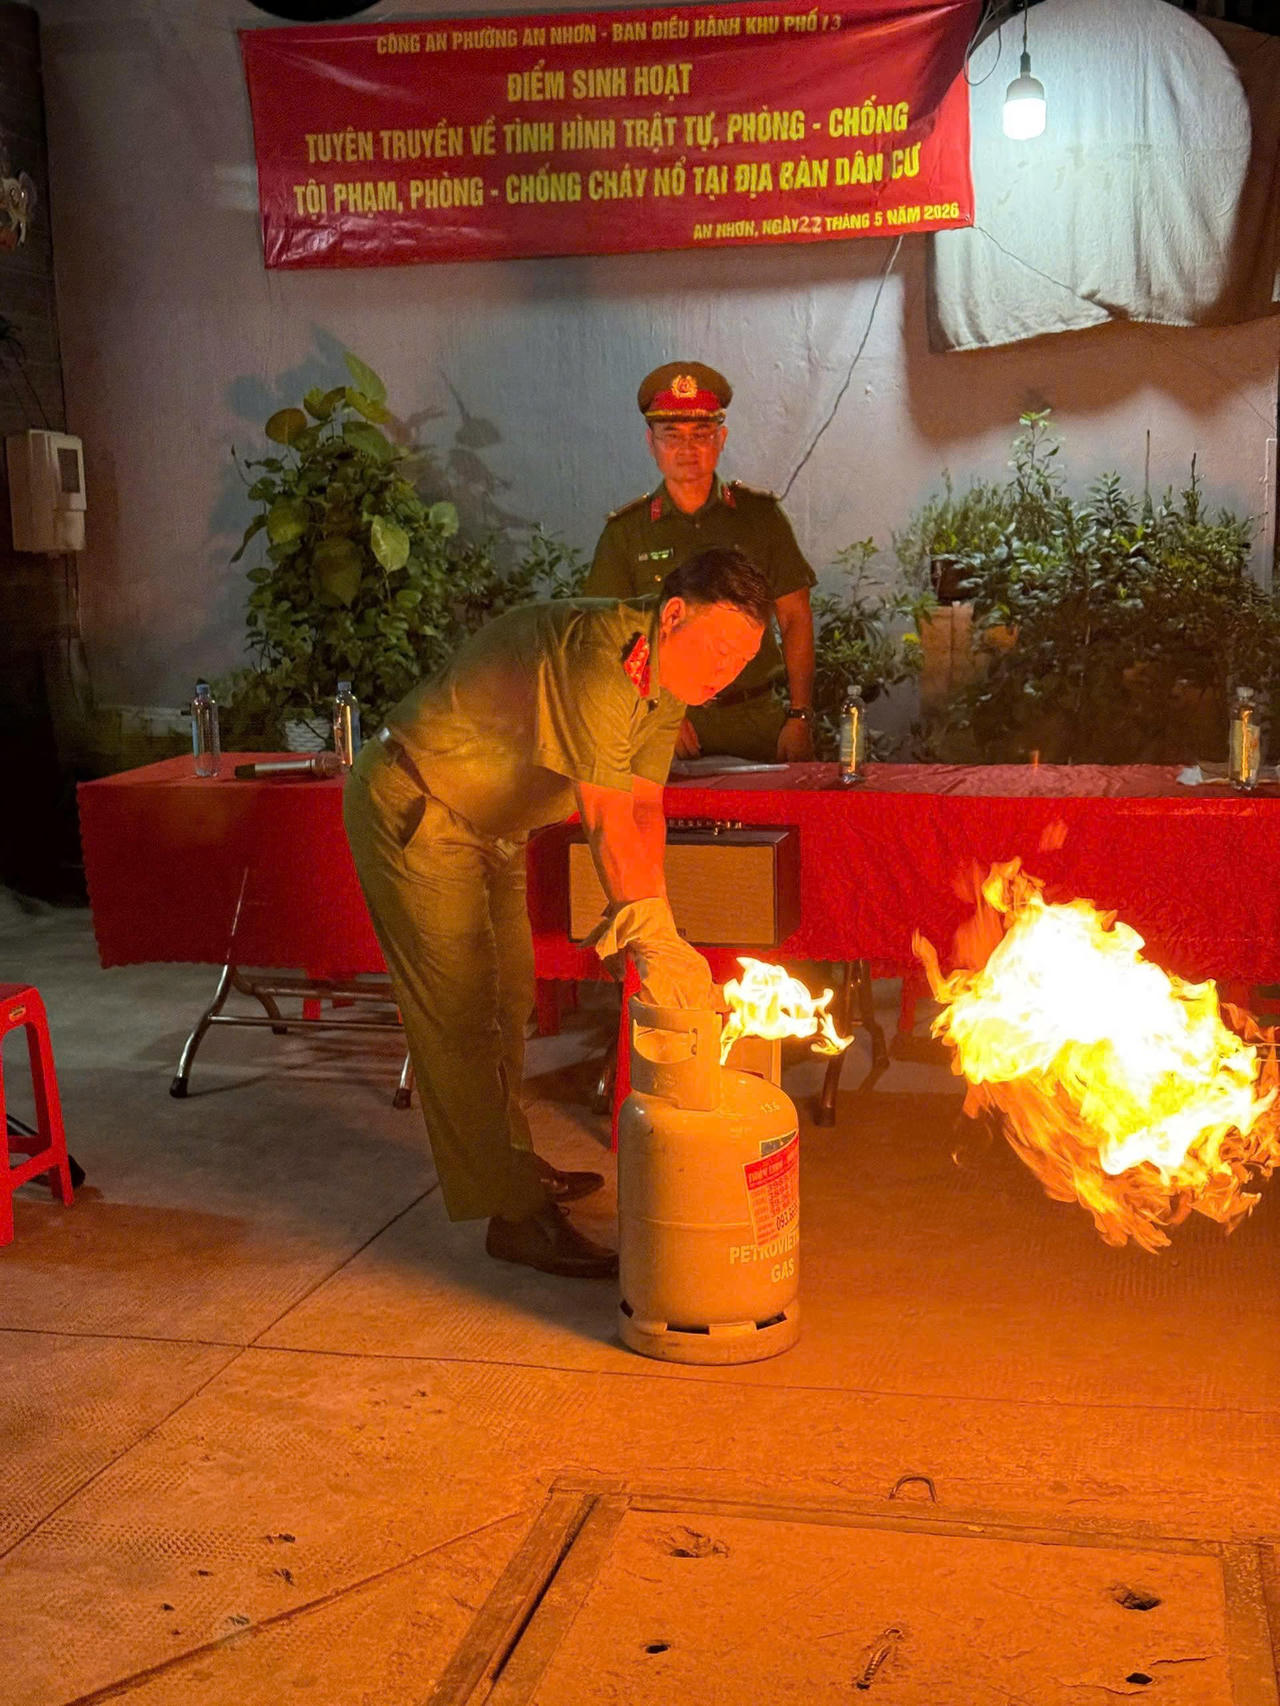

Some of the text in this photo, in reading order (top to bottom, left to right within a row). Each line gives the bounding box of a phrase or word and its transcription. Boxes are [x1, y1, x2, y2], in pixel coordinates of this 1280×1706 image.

[376, 32, 420, 54] CÔNG
[425, 33, 448, 52] AN
[452, 25, 518, 50] PHƯỜNG
[522, 27, 546, 46] AN
[550, 23, 597, 44] NHƠN
[612, 22, 648, 42] BAN
[694, 14, 741, 38] HÀNH
[746, 15, 780, 35] KHU
[784, 7, 819, 32] PHỐ
[507, 58, 693, 102] ĐIỂM SINH HOẠT
[305, 125, 374, 163] TUYÊN
[379, 117, 464, 161] TRUYỀN
[470, 114, 497, 156] VỀ
[503, 117, 555, 154] TÌNH
[561, 113, 616, 150] HÌNH
[622, 111, 677, 154] TRẬT
[683, 111, 719, 152] TỰ,
[727, 104, 806, 144] PHÒNG
[828, 94, 909, 138] CHỐNG
[293, 177, 328, 221] TỘI
[333, 180, 404, 219] PHẠM,
[409, 170, 484, 210] PHÒNG
[505, 162, 582, 205] CHỐNG
[588, 162, 648, 200] CHÁY
[653, 155, 687, 198] NỔ
[692, 164, 729, 201] TẠI
[734, 162, 773, 199] ĐỊA
[779, 154, 830, 191] BÀN
[835, 150, 884, 187] DÂN
[891, 141, 922, 180] CƯ
[693, 223, 713, 241] AN
[715, 219, 759, 239] NHƠN,
[762, 215, 800, 236] NGÀY
[825, 210, 870, 232] THÁNG
[873, 210, 883, 228] 5
[887, 204, 921, 226] NĂM
[924, 202, 960, 221] 2026
[770, 1257, 795, 1283] GAS
